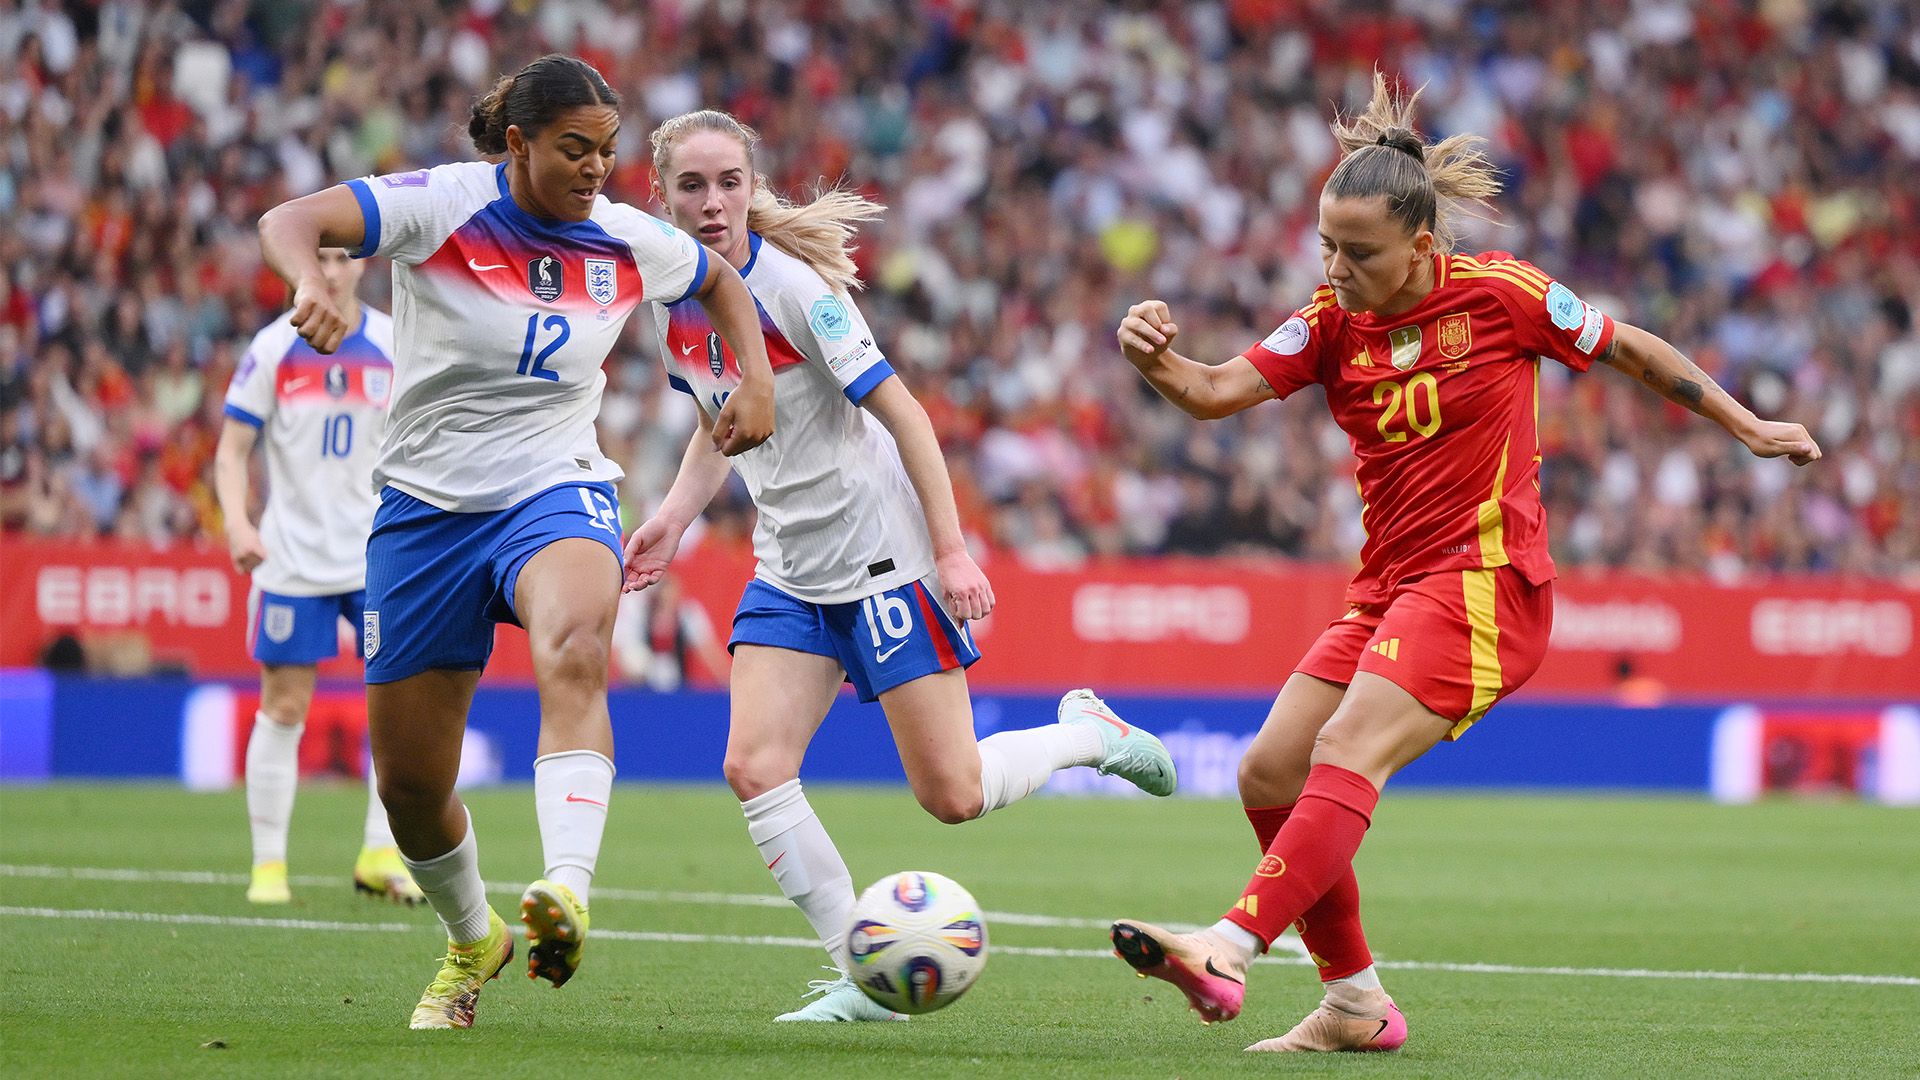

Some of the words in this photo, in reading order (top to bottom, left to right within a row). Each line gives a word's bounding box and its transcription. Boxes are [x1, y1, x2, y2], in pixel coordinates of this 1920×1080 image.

[516, 312, 571, 382] 12
[1372, 371, 1442, 443] 20
[321, 413, 354, 458] 10
[577, 487, 617, 537] 12
[863, 592, 913, 648] 16
